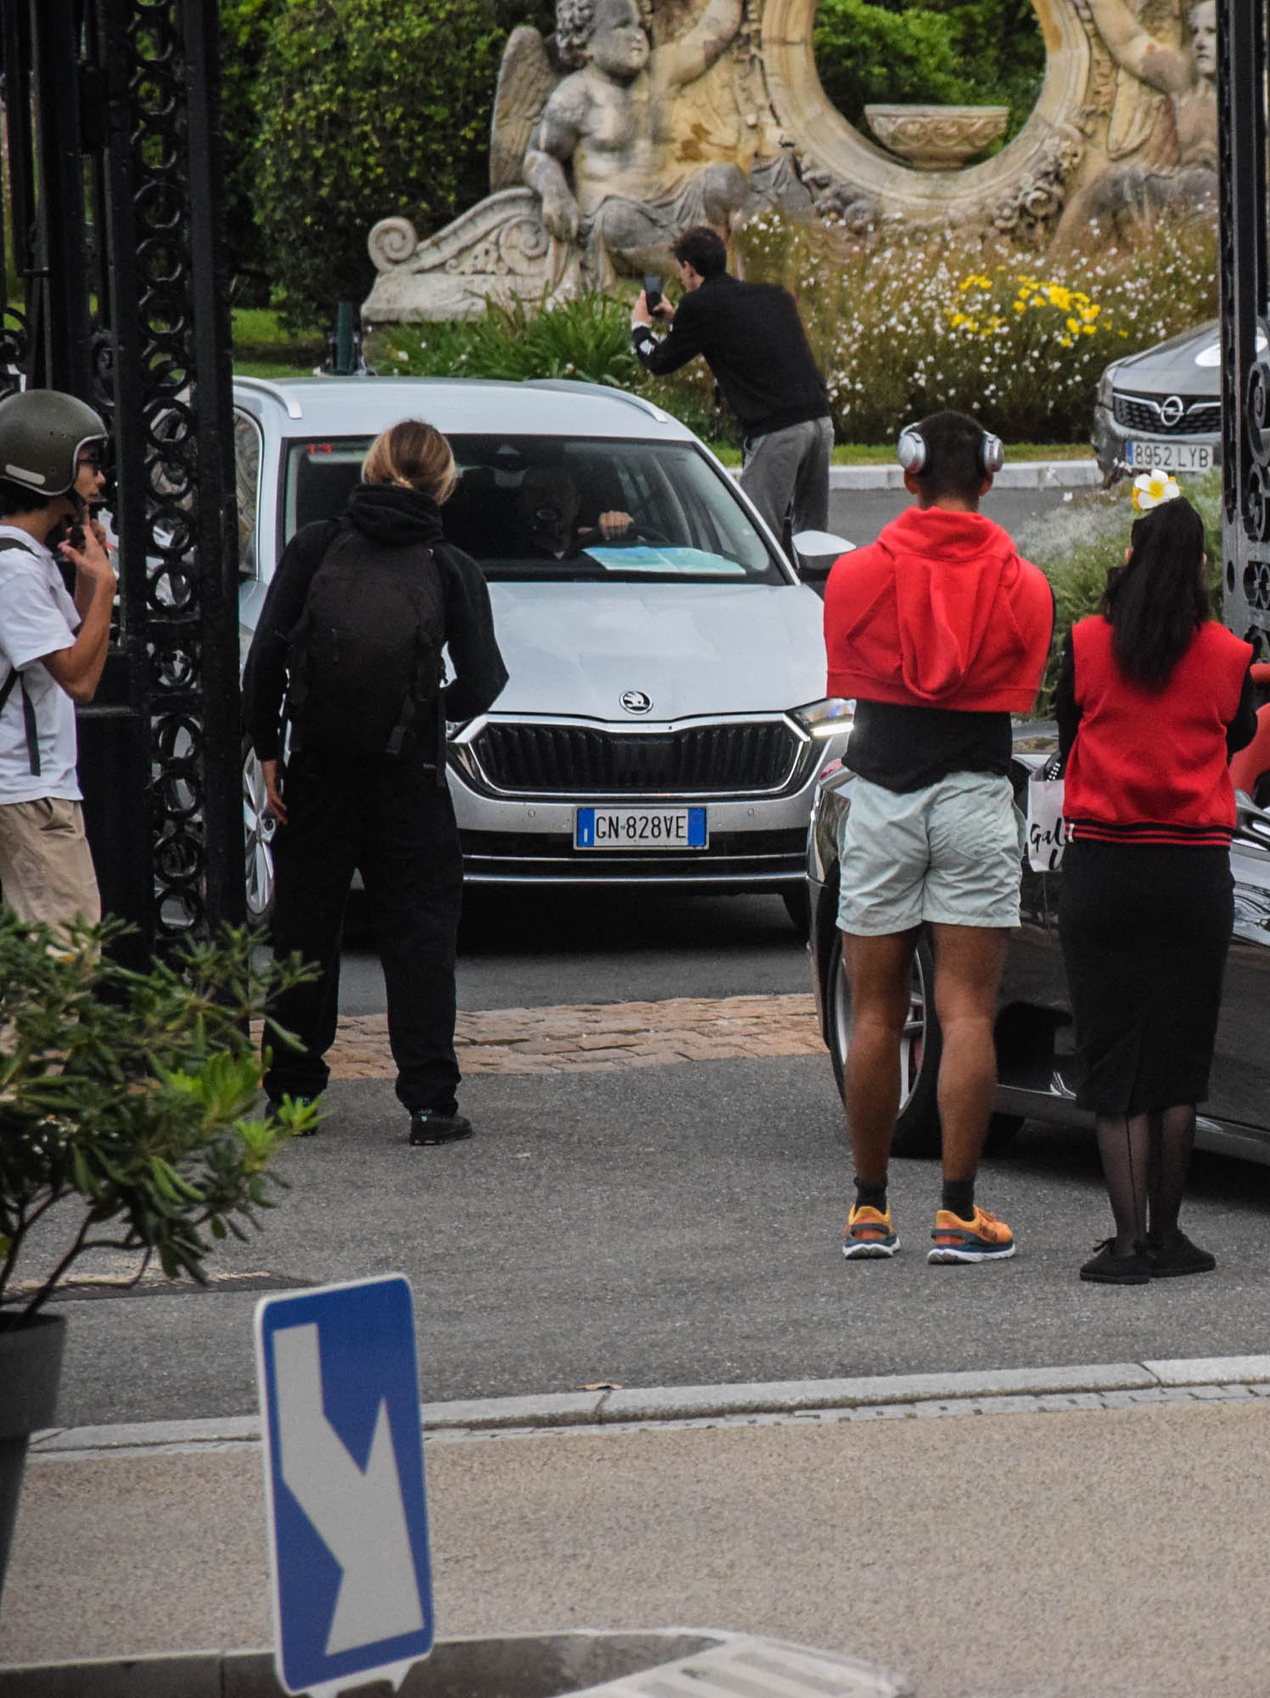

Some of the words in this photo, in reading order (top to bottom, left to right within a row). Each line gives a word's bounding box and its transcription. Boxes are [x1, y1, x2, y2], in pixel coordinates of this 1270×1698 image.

[1135, 444, 1172, 467] 8952
[1178, 447, 1209, 468] LYB
[1030, 817, 1066, 853] Gal
